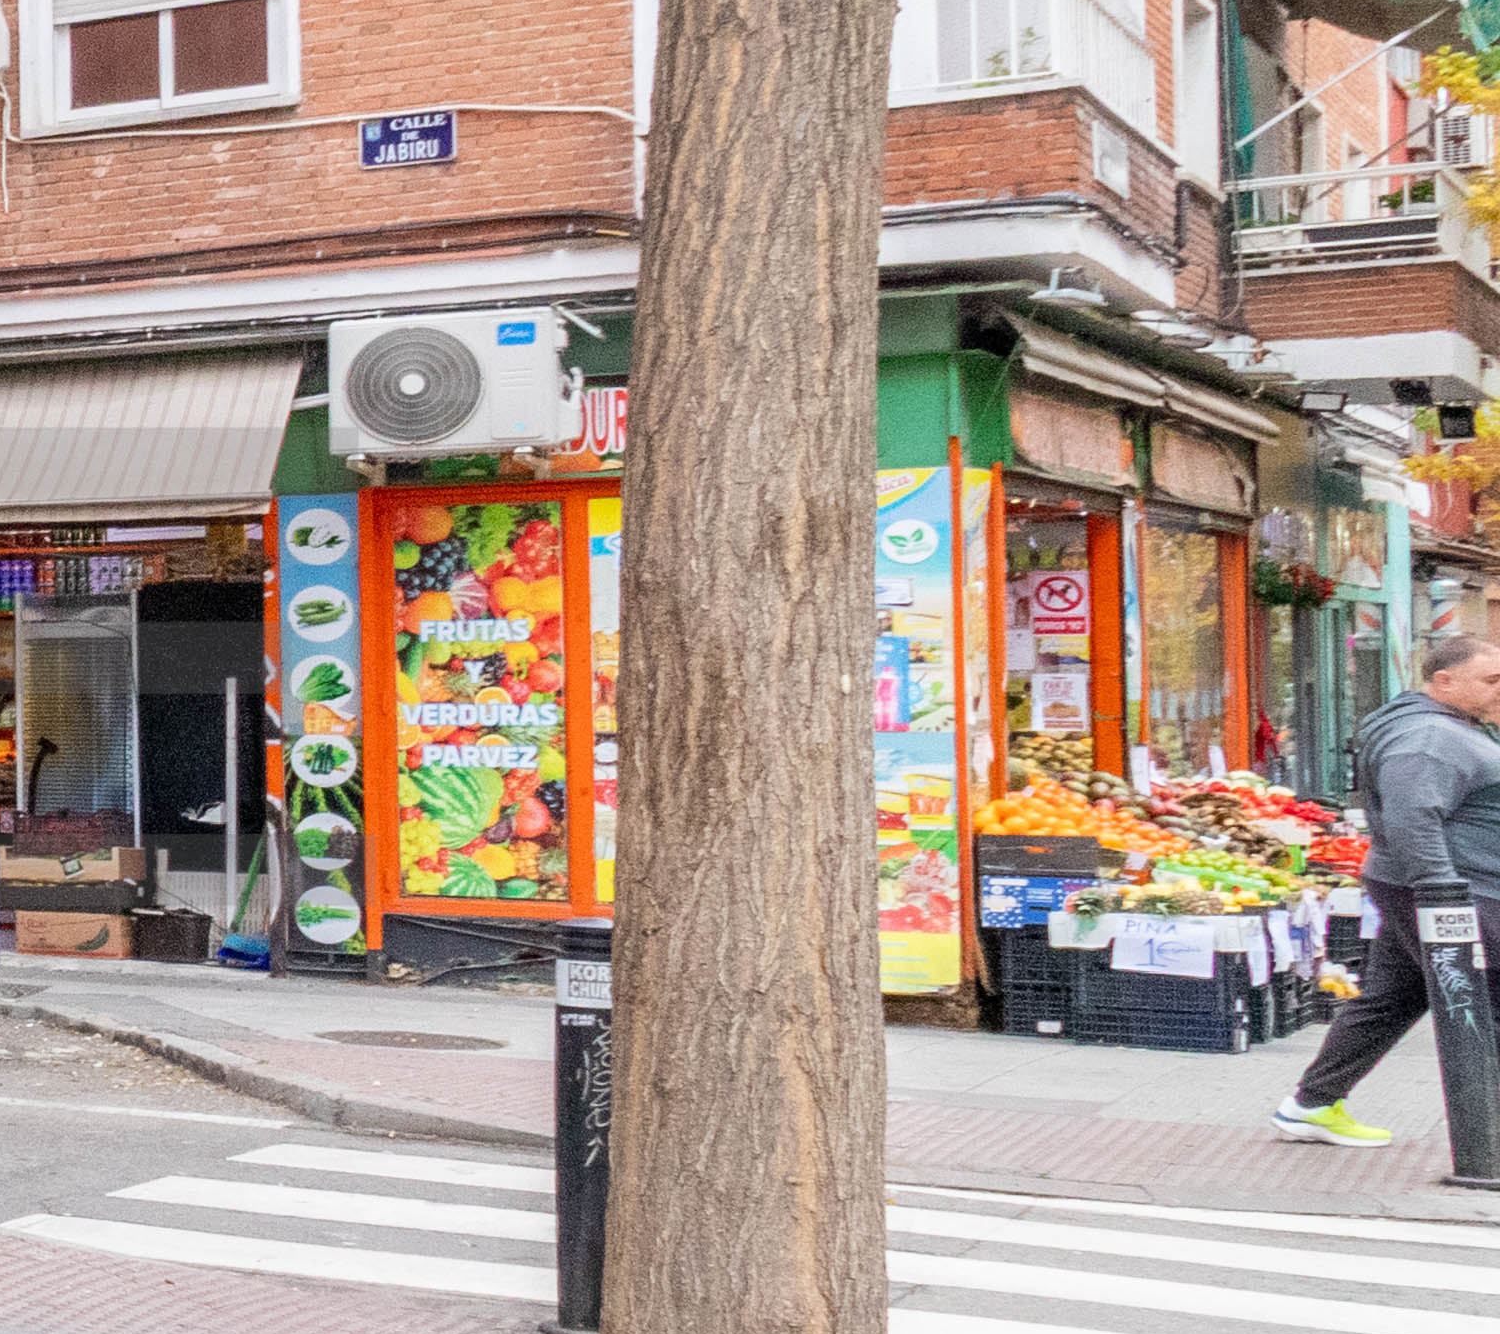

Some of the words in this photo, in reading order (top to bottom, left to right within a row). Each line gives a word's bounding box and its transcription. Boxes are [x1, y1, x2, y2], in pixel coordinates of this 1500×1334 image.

[389, 113, 447, 131] CALLE
[401, 131, 419, 141] DE
[374, 139, 439, 163] JABIRU
[419, 619, 530, 643] FRUTAS
[463, 660, 485, 684] Y
[403, 703, 558, 727] VERDURAS
[422, 744, 538, 768] PARVEZ
